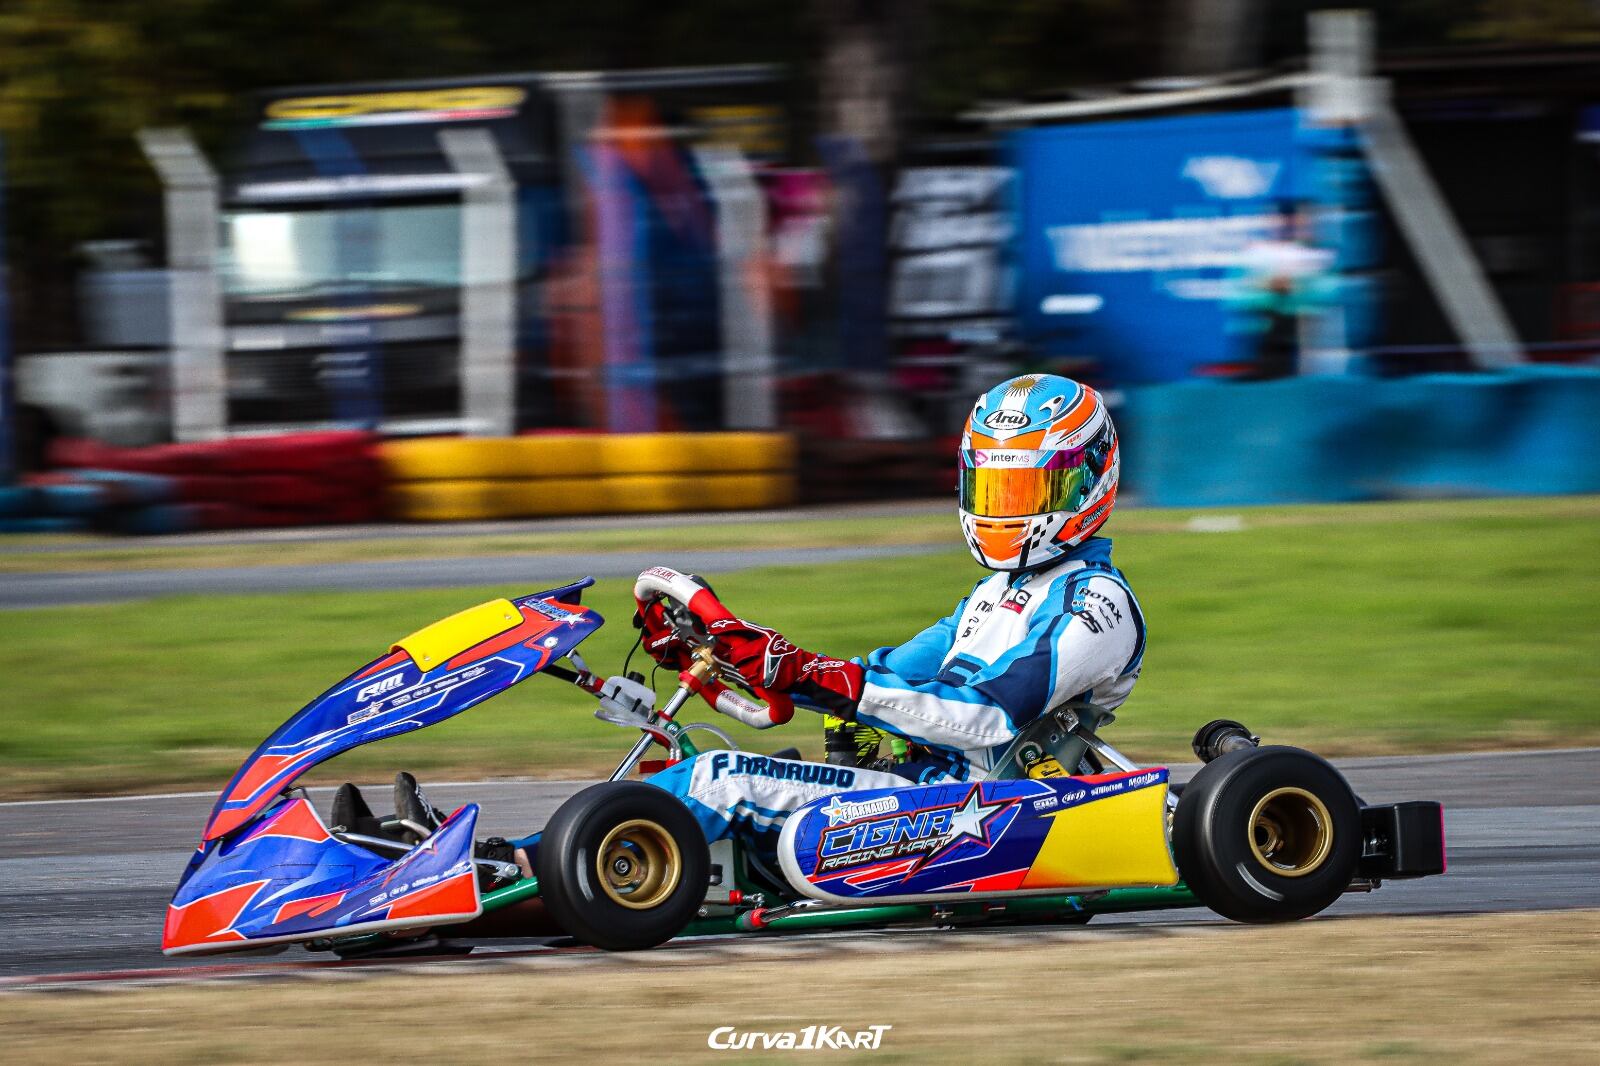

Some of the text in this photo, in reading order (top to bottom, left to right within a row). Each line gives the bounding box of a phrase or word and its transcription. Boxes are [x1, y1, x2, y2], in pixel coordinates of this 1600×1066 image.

[985, 411, 1026, 425] Arai
[990, 452, 1030, 463] interMS
[1078, 587, 1123, 625] ROTAX
[821, 806, 957, 857] CIGNA
[897, 836, 953, 856] KART
[821, 845, 896, 870] RACING
